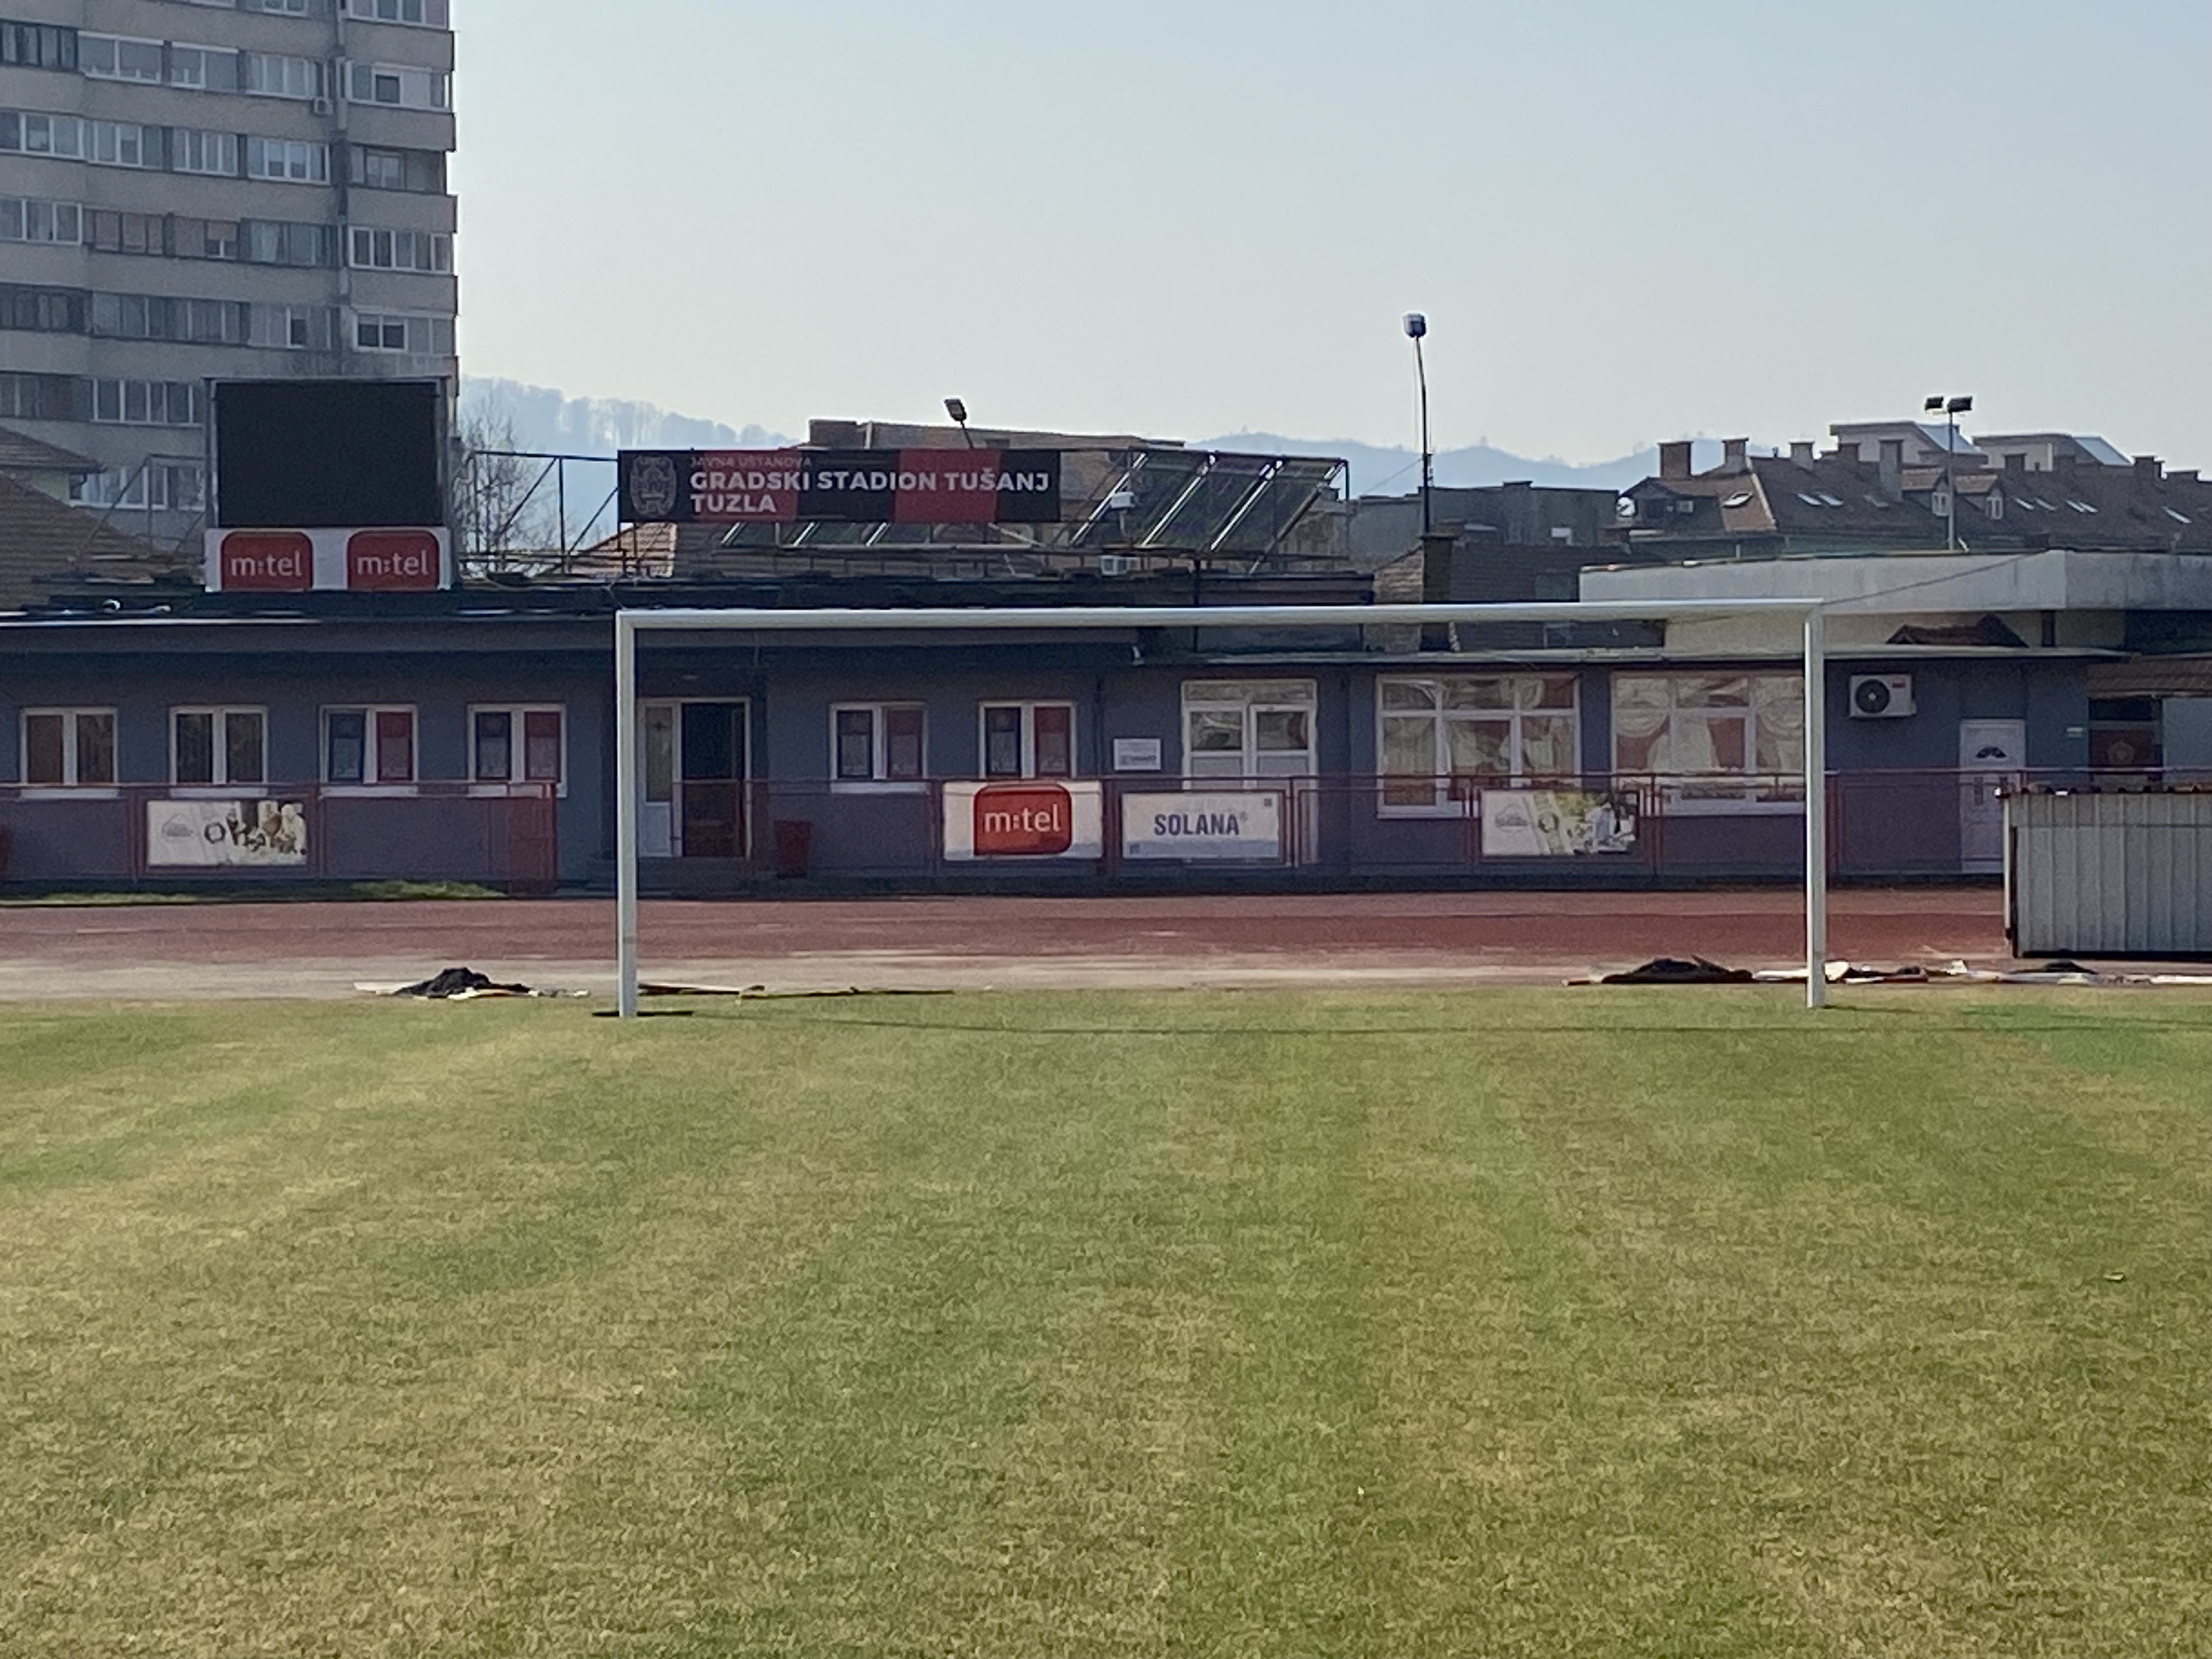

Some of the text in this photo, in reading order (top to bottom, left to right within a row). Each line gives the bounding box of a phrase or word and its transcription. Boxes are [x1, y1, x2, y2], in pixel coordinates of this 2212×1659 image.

[690, 467, 1049, 492] GRADSKI STADION TUŠANJ
[690, 494, 777, 513] TUZLA
[230, 550, 302, 577] m:tel
[357, 550, 430, 575] m:tel
[984, 803, 1062, 833] m:tel
[1154, 813, 1240, 836] SOLANA
